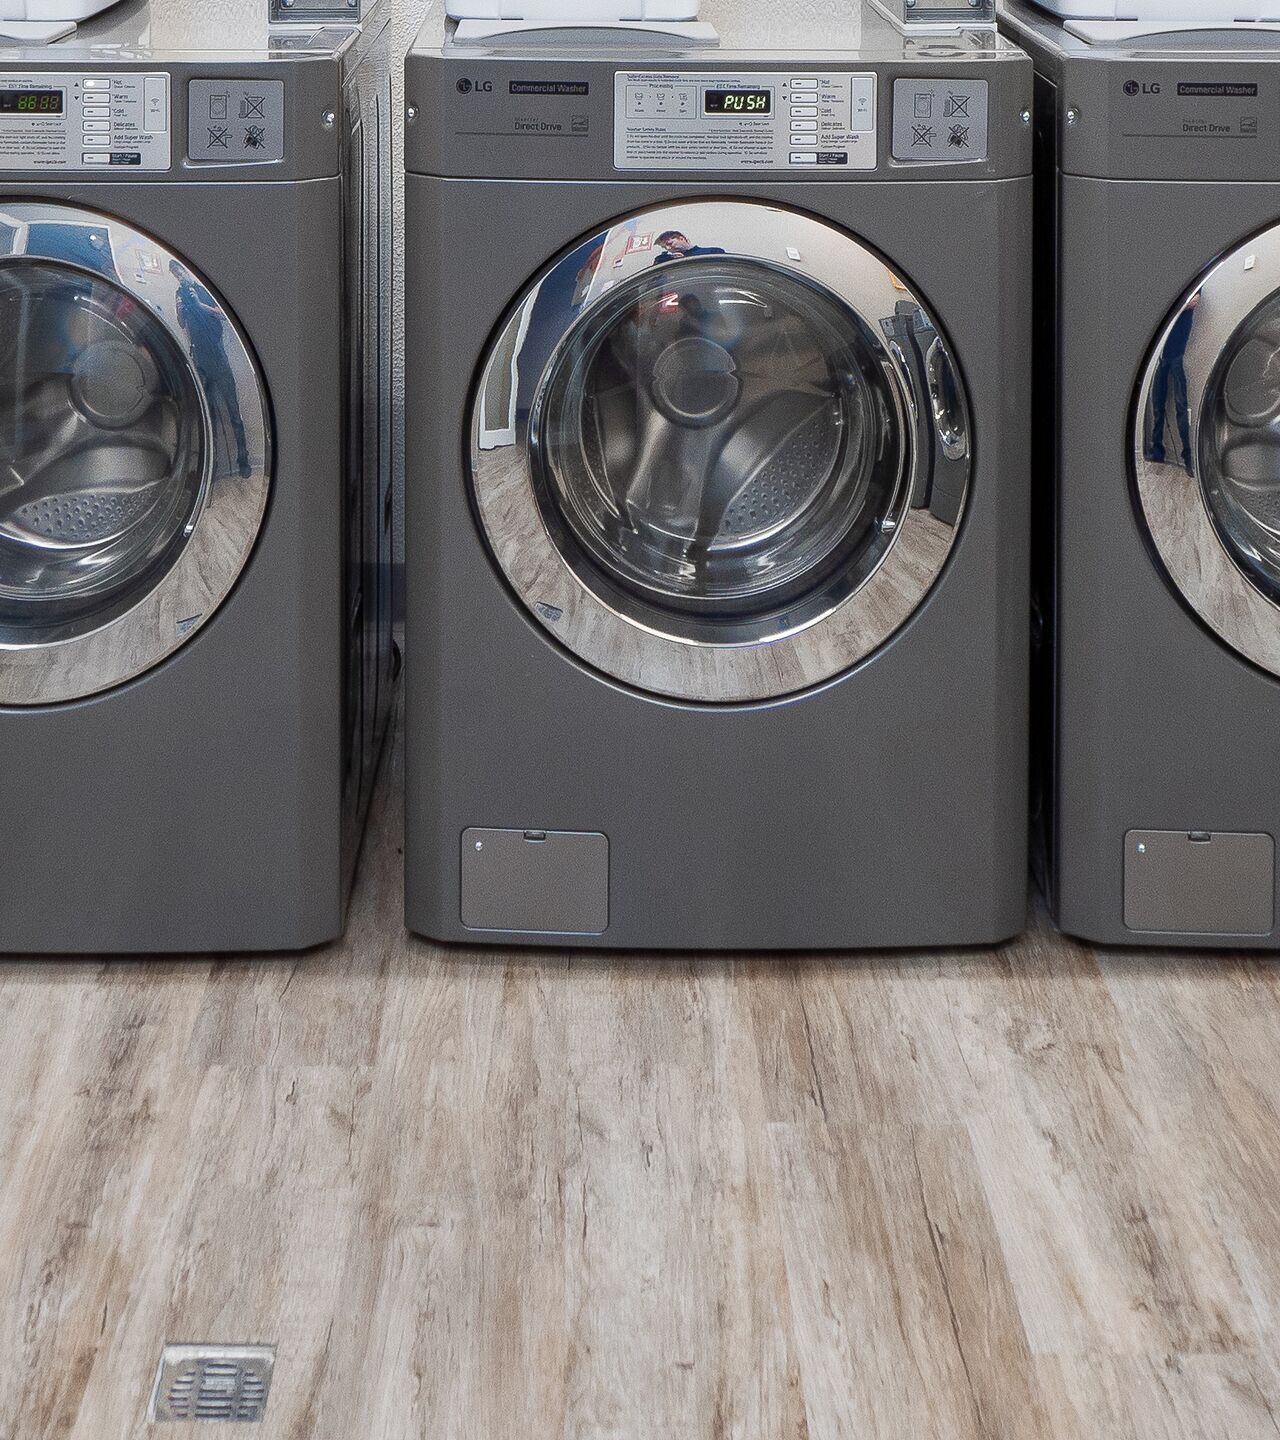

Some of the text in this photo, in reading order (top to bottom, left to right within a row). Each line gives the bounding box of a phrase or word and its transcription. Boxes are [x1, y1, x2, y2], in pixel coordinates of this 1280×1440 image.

[511, 84, 587, 93] Commercial Washer
[1180, 85, 1256, 94] Commercial Washer
[724, 95, 766, 109] PUSH
[515, 122, 562, 131] Direct Drive
[1183, 123, 1231, 132] Direct Drive
